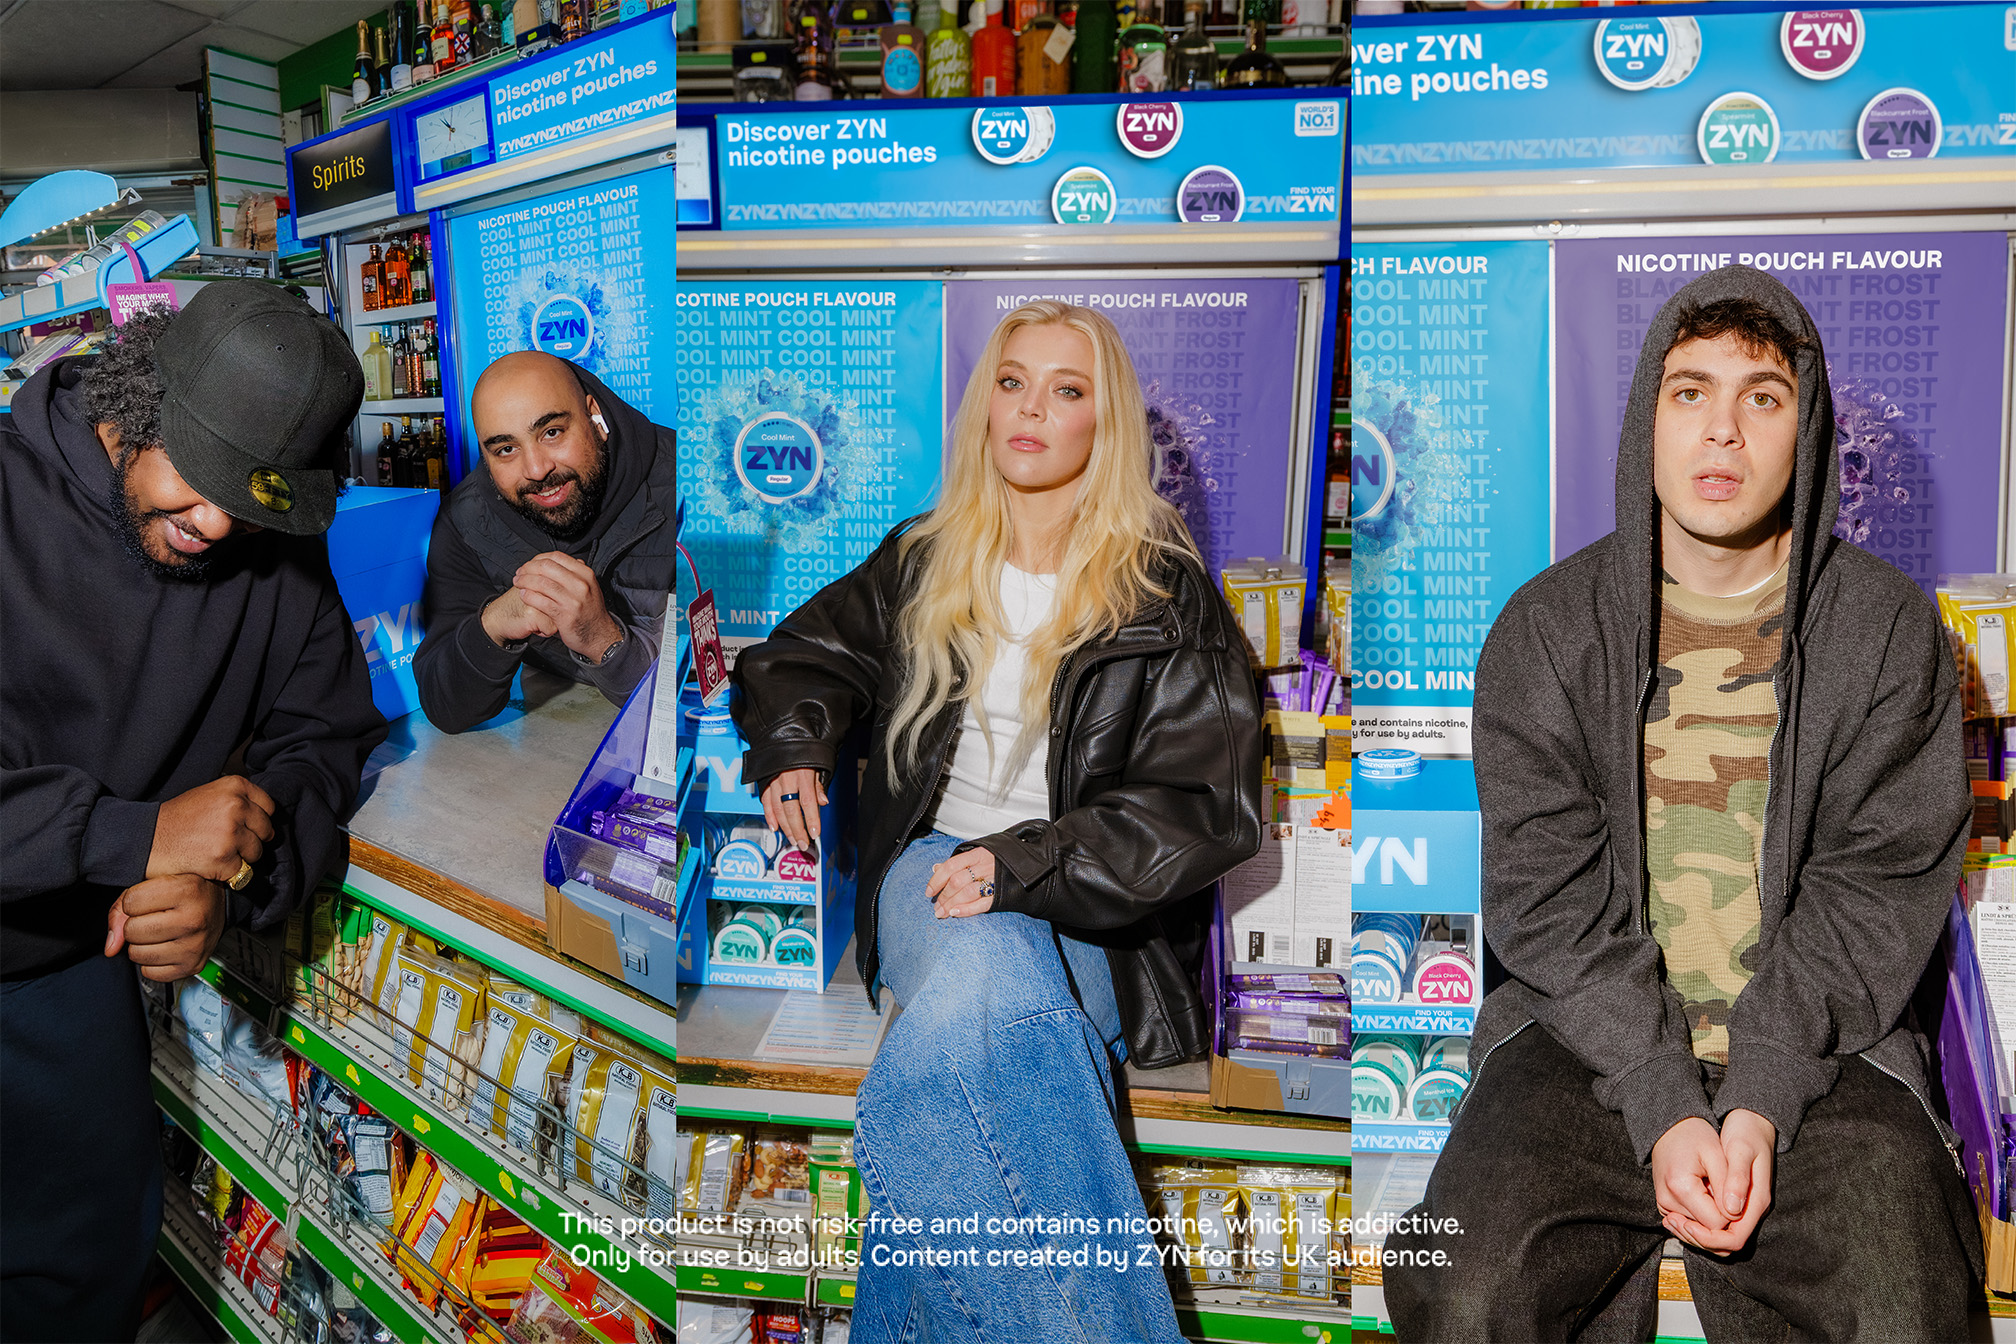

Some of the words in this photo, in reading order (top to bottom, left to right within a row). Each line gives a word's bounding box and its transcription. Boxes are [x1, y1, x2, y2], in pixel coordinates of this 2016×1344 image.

[1802, 12, 1819, 20] Black
[1820, 12, 1844, 20] Cherry
[1794, 22, 1852, 48] ZYN
[1416, 34, 1482, 62] ZYN
[1606, 34, 1664, 58] ZYN
[494, 67, 570, 106] Discover
[574, 48, 615, 78] ZYN
[1411, 63, 1548, 101] pouches
[497, 90, 566, 126] nicotine
[572, 60, 658, 104] pouches
[1127, 113, 1174, 132] ZYN
[1300, 114, 1334, 127] NO.1
[1722, 112, 1756, 121] Spearmint
[728, 121, 830, 142] Discover
[837, 118, 886, 140] ZYN
[982, 120, 1026, 138] ZYN
[1709, 124, 1769, 148] ZYN
[1868, 120, 1930, 146] ZYN
[728, 144, 825, 166] nicotine
[833, 141, 937, 170] pouches
[312, 155, 366, 191] Spirits
[1311, 186, 1334, 194] YOUR
[478, 210, 530, 230] NICOTINE
[533, 199, 575, 218] POUCH
[578, 185, 638, 208] FLAVOUR
[1060, 192, 1108, 212] ZYN
[1186, 192, 1236, 212] ZYN
[480, 227, 515, 244] COOL
[518, 218, 552, 236] MINT
[556, 209, 596, 228] COOL
[600, 199, 639, 220] MINT
[480, 242, 516, 258] COOL
[519, 233, 553, 250] MINT
[1382, 256, 1488, 274] FLAVOUR
[1832, 250, 1942, 269] FLAVOUR
[1418, 279, 1488, 300] MINT
[1850, 274, 1941, 296] FROST
[118, 300, 140, 308] YOUR
[745, 292, 808, 306] POUCH
[814, 292, 896, 306] FLAVOUR
[1090, 294, 1156, 308] POUCH
[1161, 292, 1248, 308] FLAVOUR
[1174, 311, 1246, 328] FROST
[1419, 304, 1488, 325] MINT
[1850, 300, 1940, 322] FROST
[540, 318, 586, 342] ZYN
[1173, 332, 1246, 348] FROST
[1420, 330, 1488, 350] MINT
[1849, 326, 1940, 348] FROST
[1172, 352, 1244, 369] FROST
[1420, 355, 1488, 375] MINT
[1848, 352, 1938, 372] FROST
[1172, 372, 1244, 388] FROST
[747, 446, 812, 470] ZYN
[1424, 528, 1490, 548] MINT
[1424, 552, 1491, 571] MINT
[1424, 576, 1491, 596] MINT
[730, 610, 780, 625] MINT
[1352, 599, 1417, 619] COOL
[1424, 600, 1492, 619] MINT
[1352, 623, 1418, 644] COOL
[1352, 646, 1418, 667] COOL
[1352, 670, 1418, 690] COOL
[1360, 718, 1378, 726] and
[1380, 718, 1422, 727] contains
[1425, 720, 1468, 729] nicotine,
[1360, 730, 1376, 738] for
[1398, 730, 1410, 740] by
[1412, 730, 1446, 738] adults.
[722, 859, 758, 875] ZYN
[780, 862, 816, 878] ZYN
[721, 942, 758, 959] ZYN
[777, 948, 814, 961] ZYN
[1352, 979, 1390, 997] ZYN
[1422, 981, 1469, 998] ZYN
[774, 1316, 795, 1324] HOOPS
